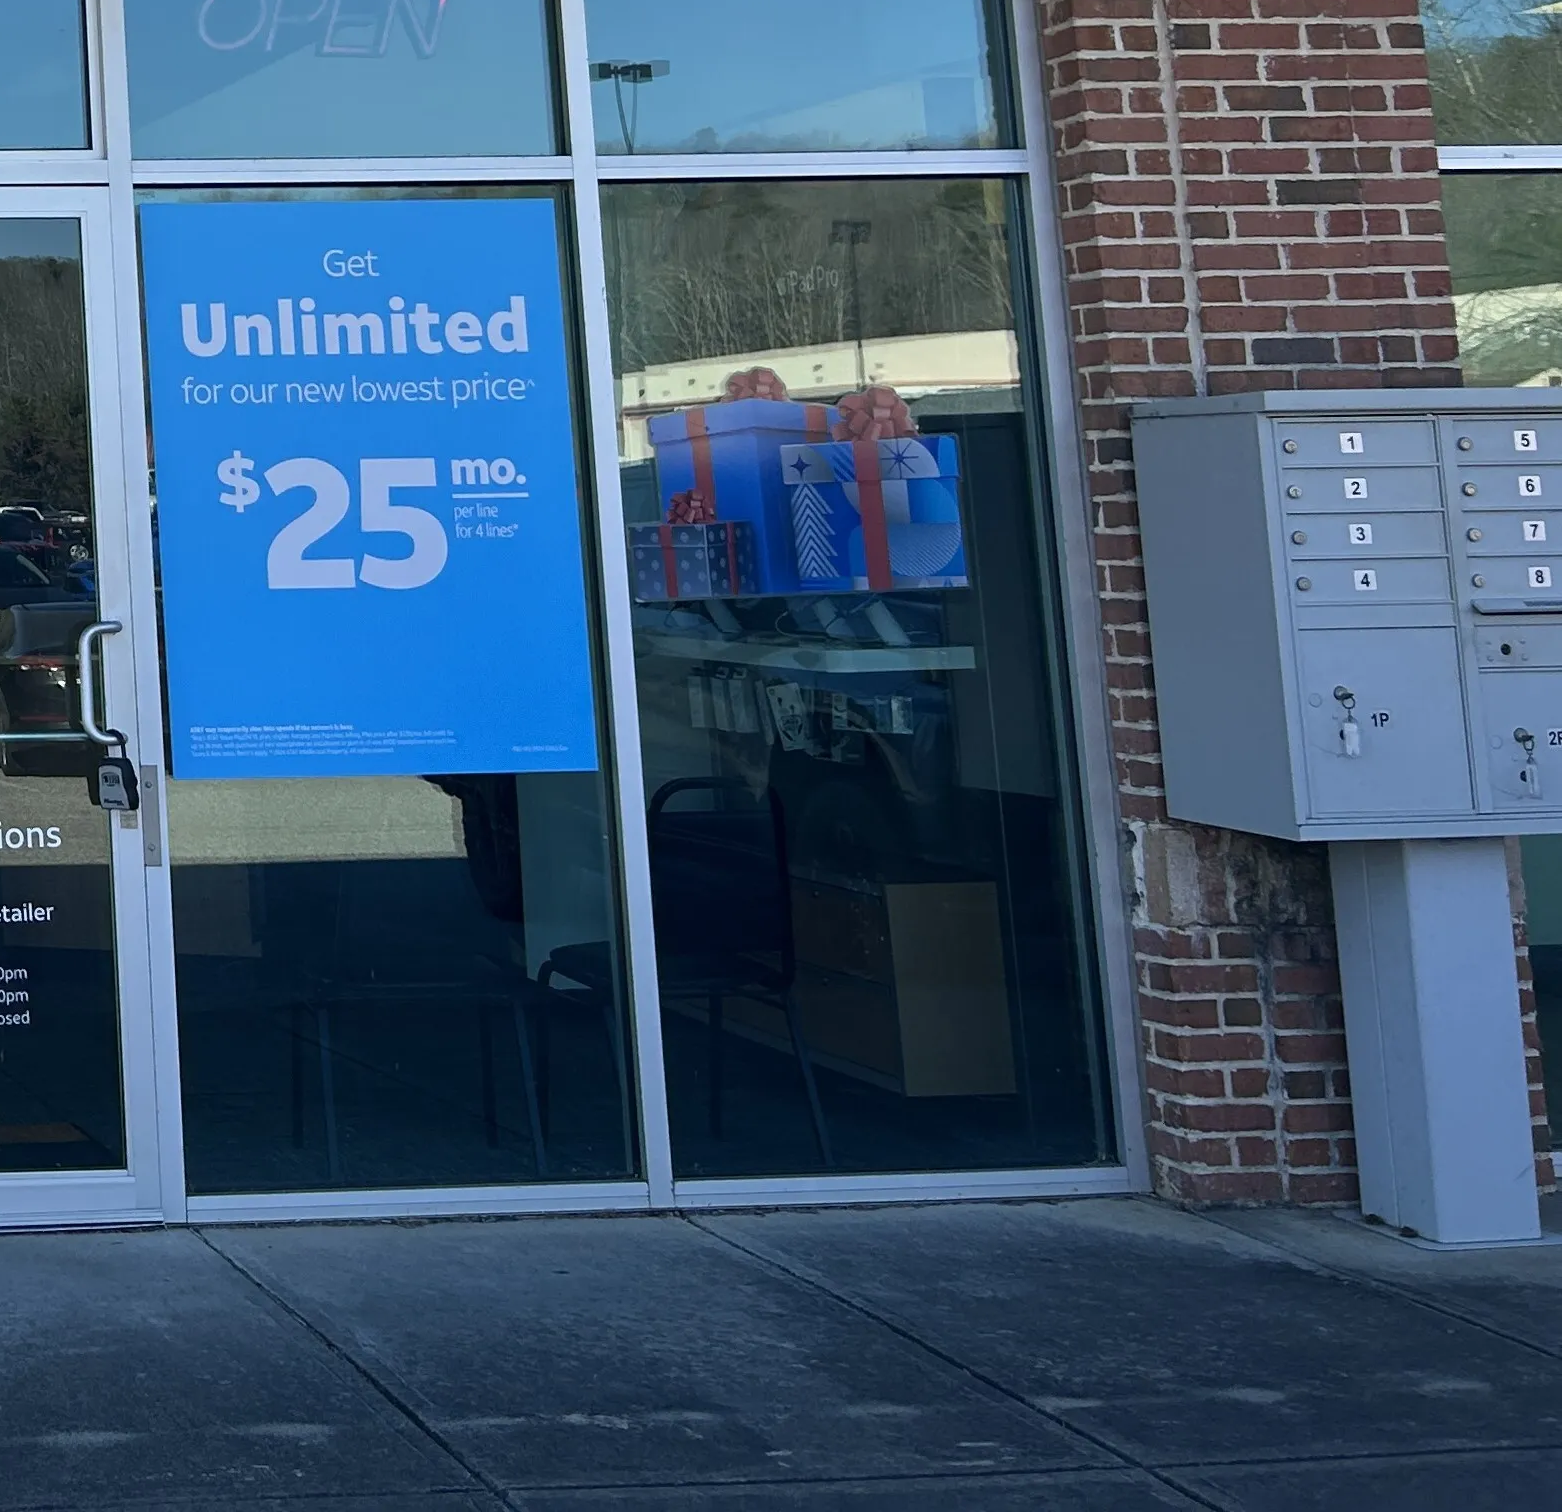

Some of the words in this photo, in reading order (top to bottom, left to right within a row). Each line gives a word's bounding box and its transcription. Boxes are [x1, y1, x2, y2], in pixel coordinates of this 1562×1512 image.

[322, 249, 380, 278] Get
[180, 295, 529, 358] Unlimited
[181, 376, 224, 405] for
[230, 381, 278, 404] our
[285, 379, 344, 403] new
[352, 374, 443, 402] lowest
[1347, 436, 1356, 450] 1
[1521, 434, 1530, 447] 5
[451, 458, 526, 485] mo.
[1351, 481, 1362, 496] 2
[1525, 479, 1535, 492] 6
[453, 506, 474, 522] per
[476, 502, 499, 518] line
[217, 450, 448, 590] $25
[455, 522, 473, 539] for
[476, 523, 484, 538] 4
[1355, 527, 1366, 541] 3
[1529, 524, 1539, 538] 7
[1360, 573, 1371, 588] 4
[1535, 570, 1544, 583] 8
[1371, 712, 1389, 727] 1P
